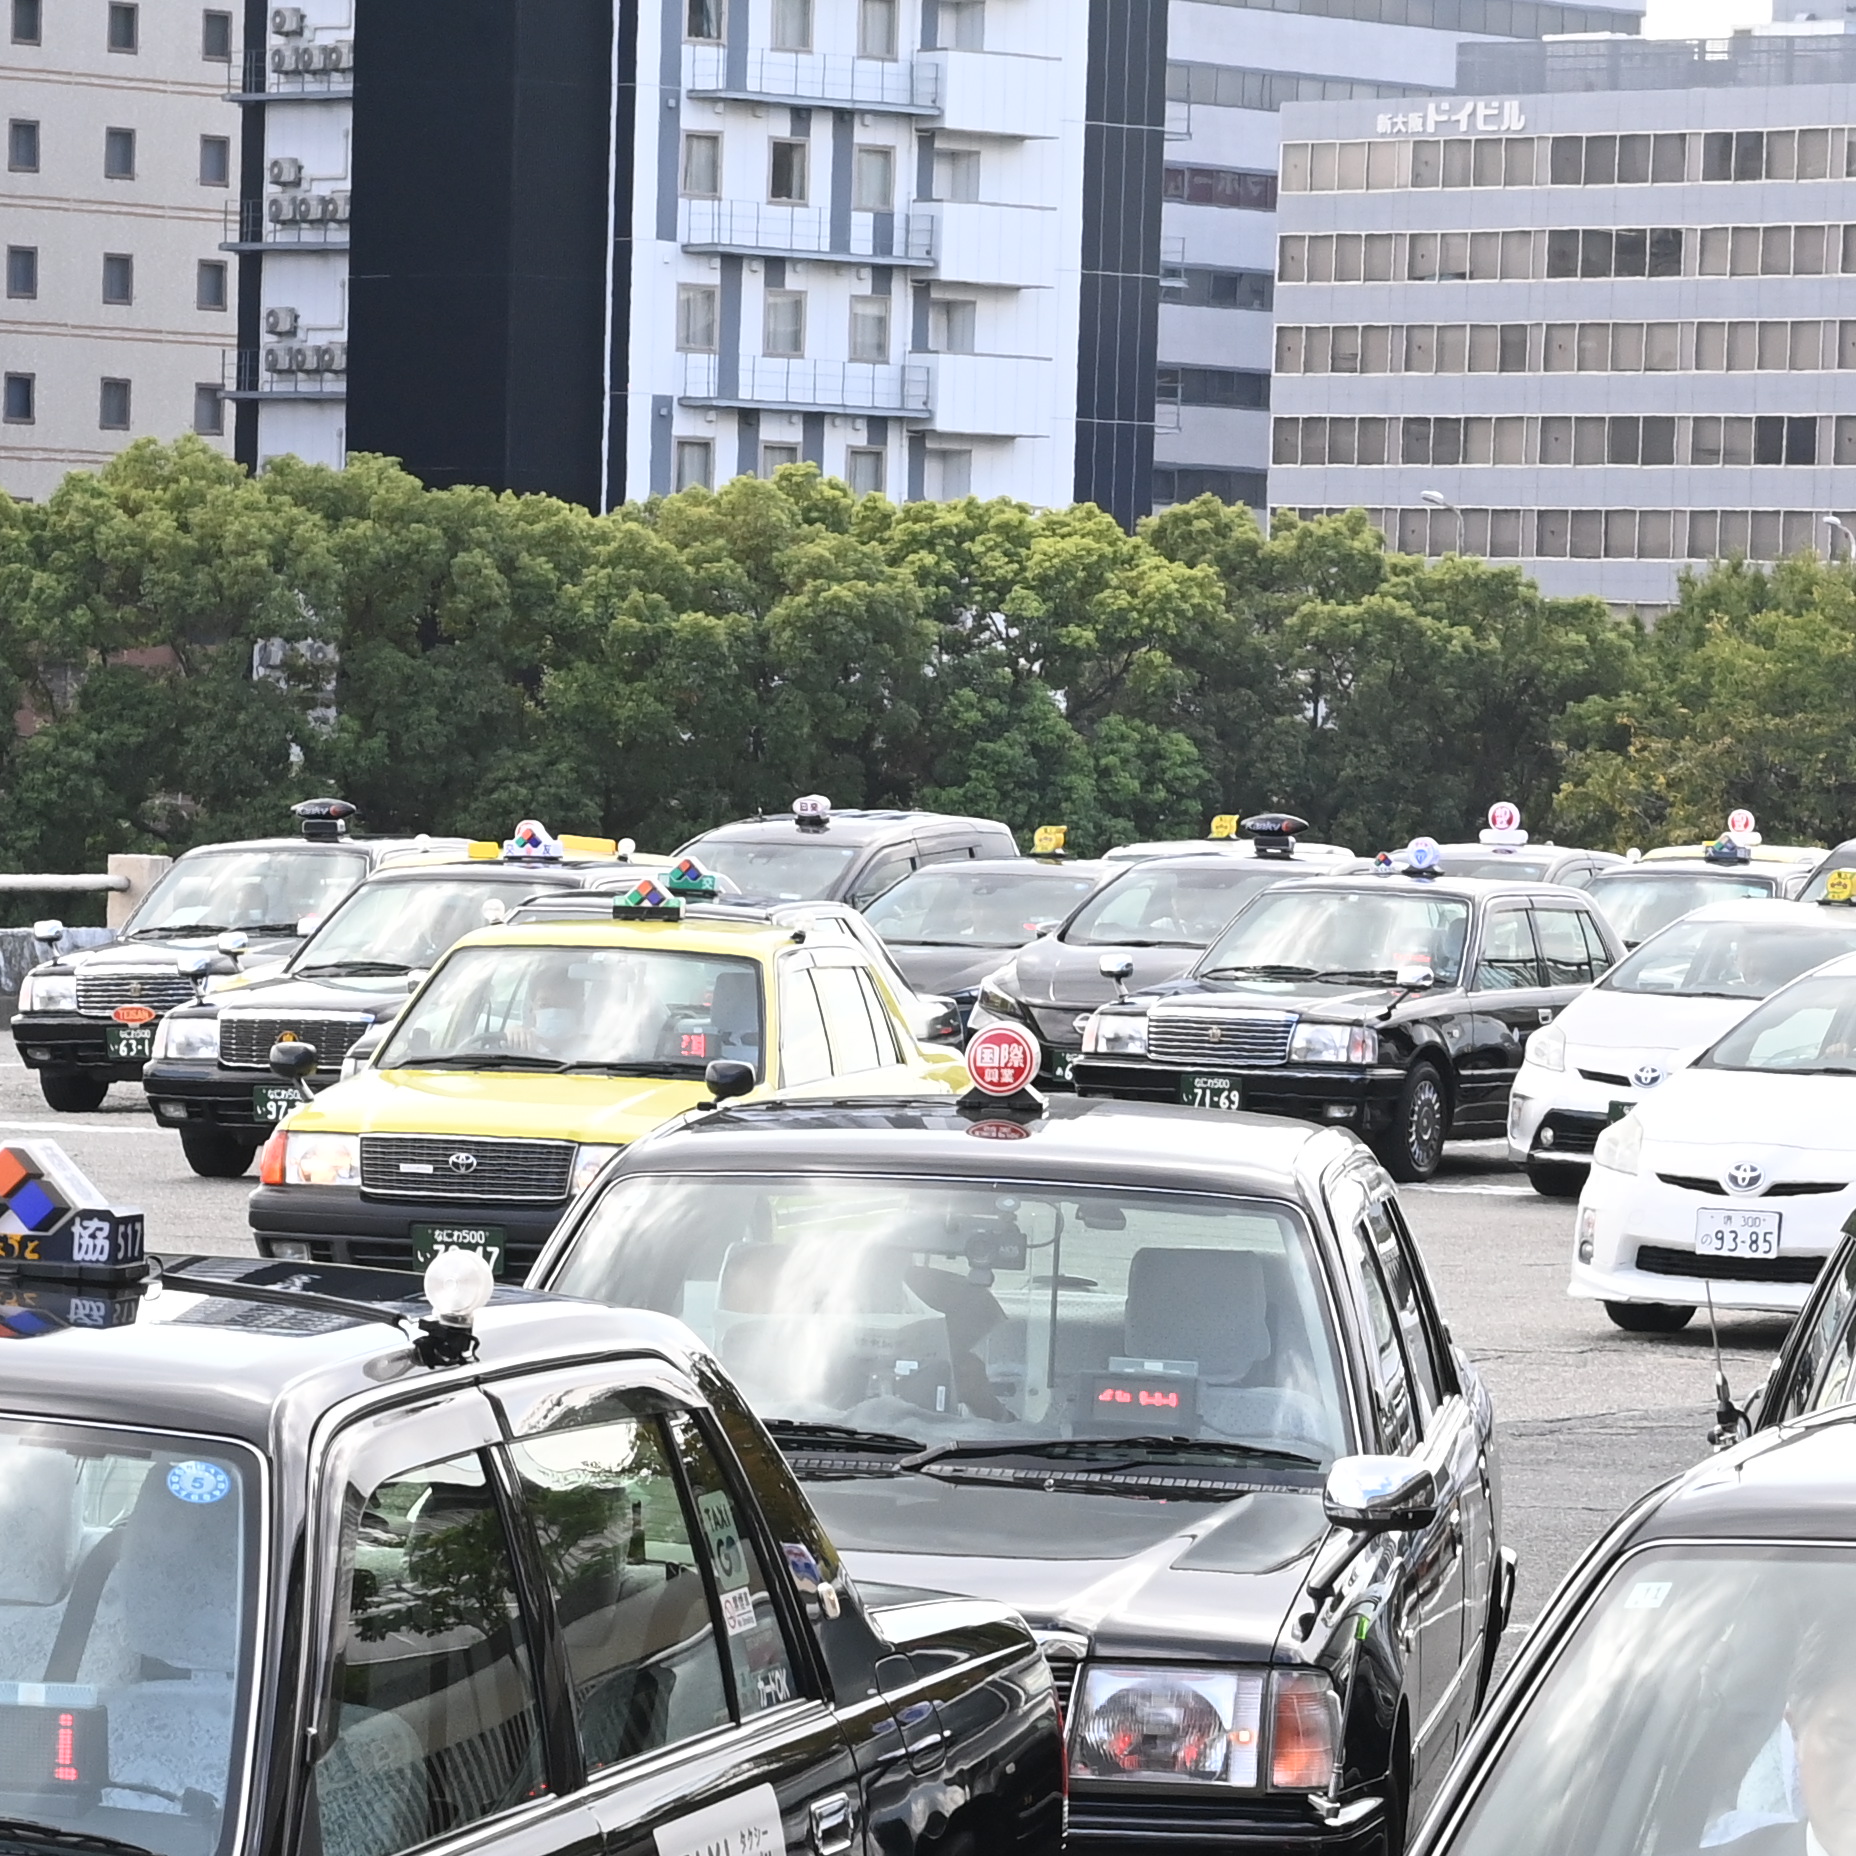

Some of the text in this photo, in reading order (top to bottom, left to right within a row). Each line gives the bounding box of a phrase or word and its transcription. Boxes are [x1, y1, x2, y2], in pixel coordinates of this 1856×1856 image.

[1376, 100, 1526, 135] 新大阪ドイビル
[976, 1042, 1024, 1068] 国際
[267, 1088, 301, 1100] なにわ50
[1194, 1088, 1240, 1110] 71-69
[71, 1216, 111, 1262] 協
[117, 1221, 143, 1260] 517
[433, 1229, 486, 1244] なにわ500
[1714, 1229, 1774, 1255] 93-85
[704, 1503, 732, 1533] TAXI
